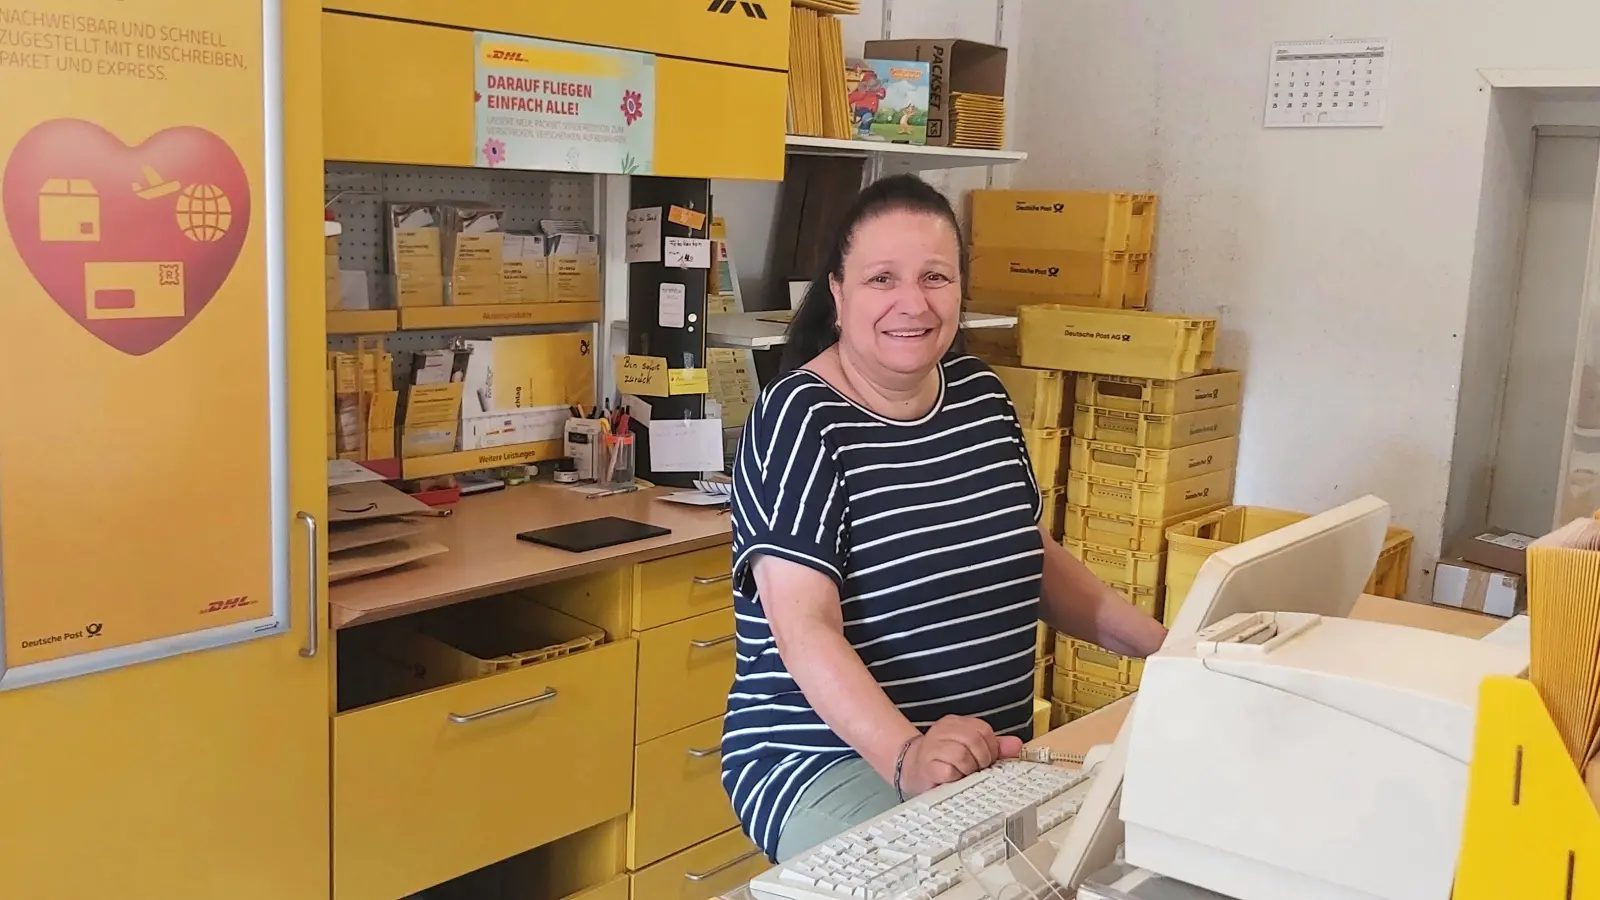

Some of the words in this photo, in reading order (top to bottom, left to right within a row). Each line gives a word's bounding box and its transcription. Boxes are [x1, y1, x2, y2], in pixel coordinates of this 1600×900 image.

[0, 8, 118, 36] NACHWEISBAR
[122, 21, 156, 39] UND
[160, 26, 226, 47] SCHNELL
[0, 28, 100, 54] ZUGESTELLT
[105, 40, 132, 57] MIT
[137, 43, 248, 70] EINSCHREIBEN,
[491, 50, 525, 62] DHL
[0, 50, 50, 70] PAKET
[56, 55, 92, 74] UND
[97, 61, 168, 81] EXPRESS.
[487, 75, 540, 93] DARAUF
[543, 80, 592, 98] FLIEGEN
[929, 45, 944, 111] PACKSET
[487, 94, 543, 113] EINFACH
[546, 99, 579, 116] ALLE!
[930, 121, 938, 136] XS
[1010, 266, 1034, 274] Deutsche
[1064, 330, 1094, 338] Deutsche
[624, 356, 637, 369] Bin
[479, 454, 502, 464] Weitere
[503, 449, 536, 460] Leistungen
[207, 596, 251, 613] DHL
[21, 635, 62, 649] Deutsche
[64, 630, 84, 641] Post
